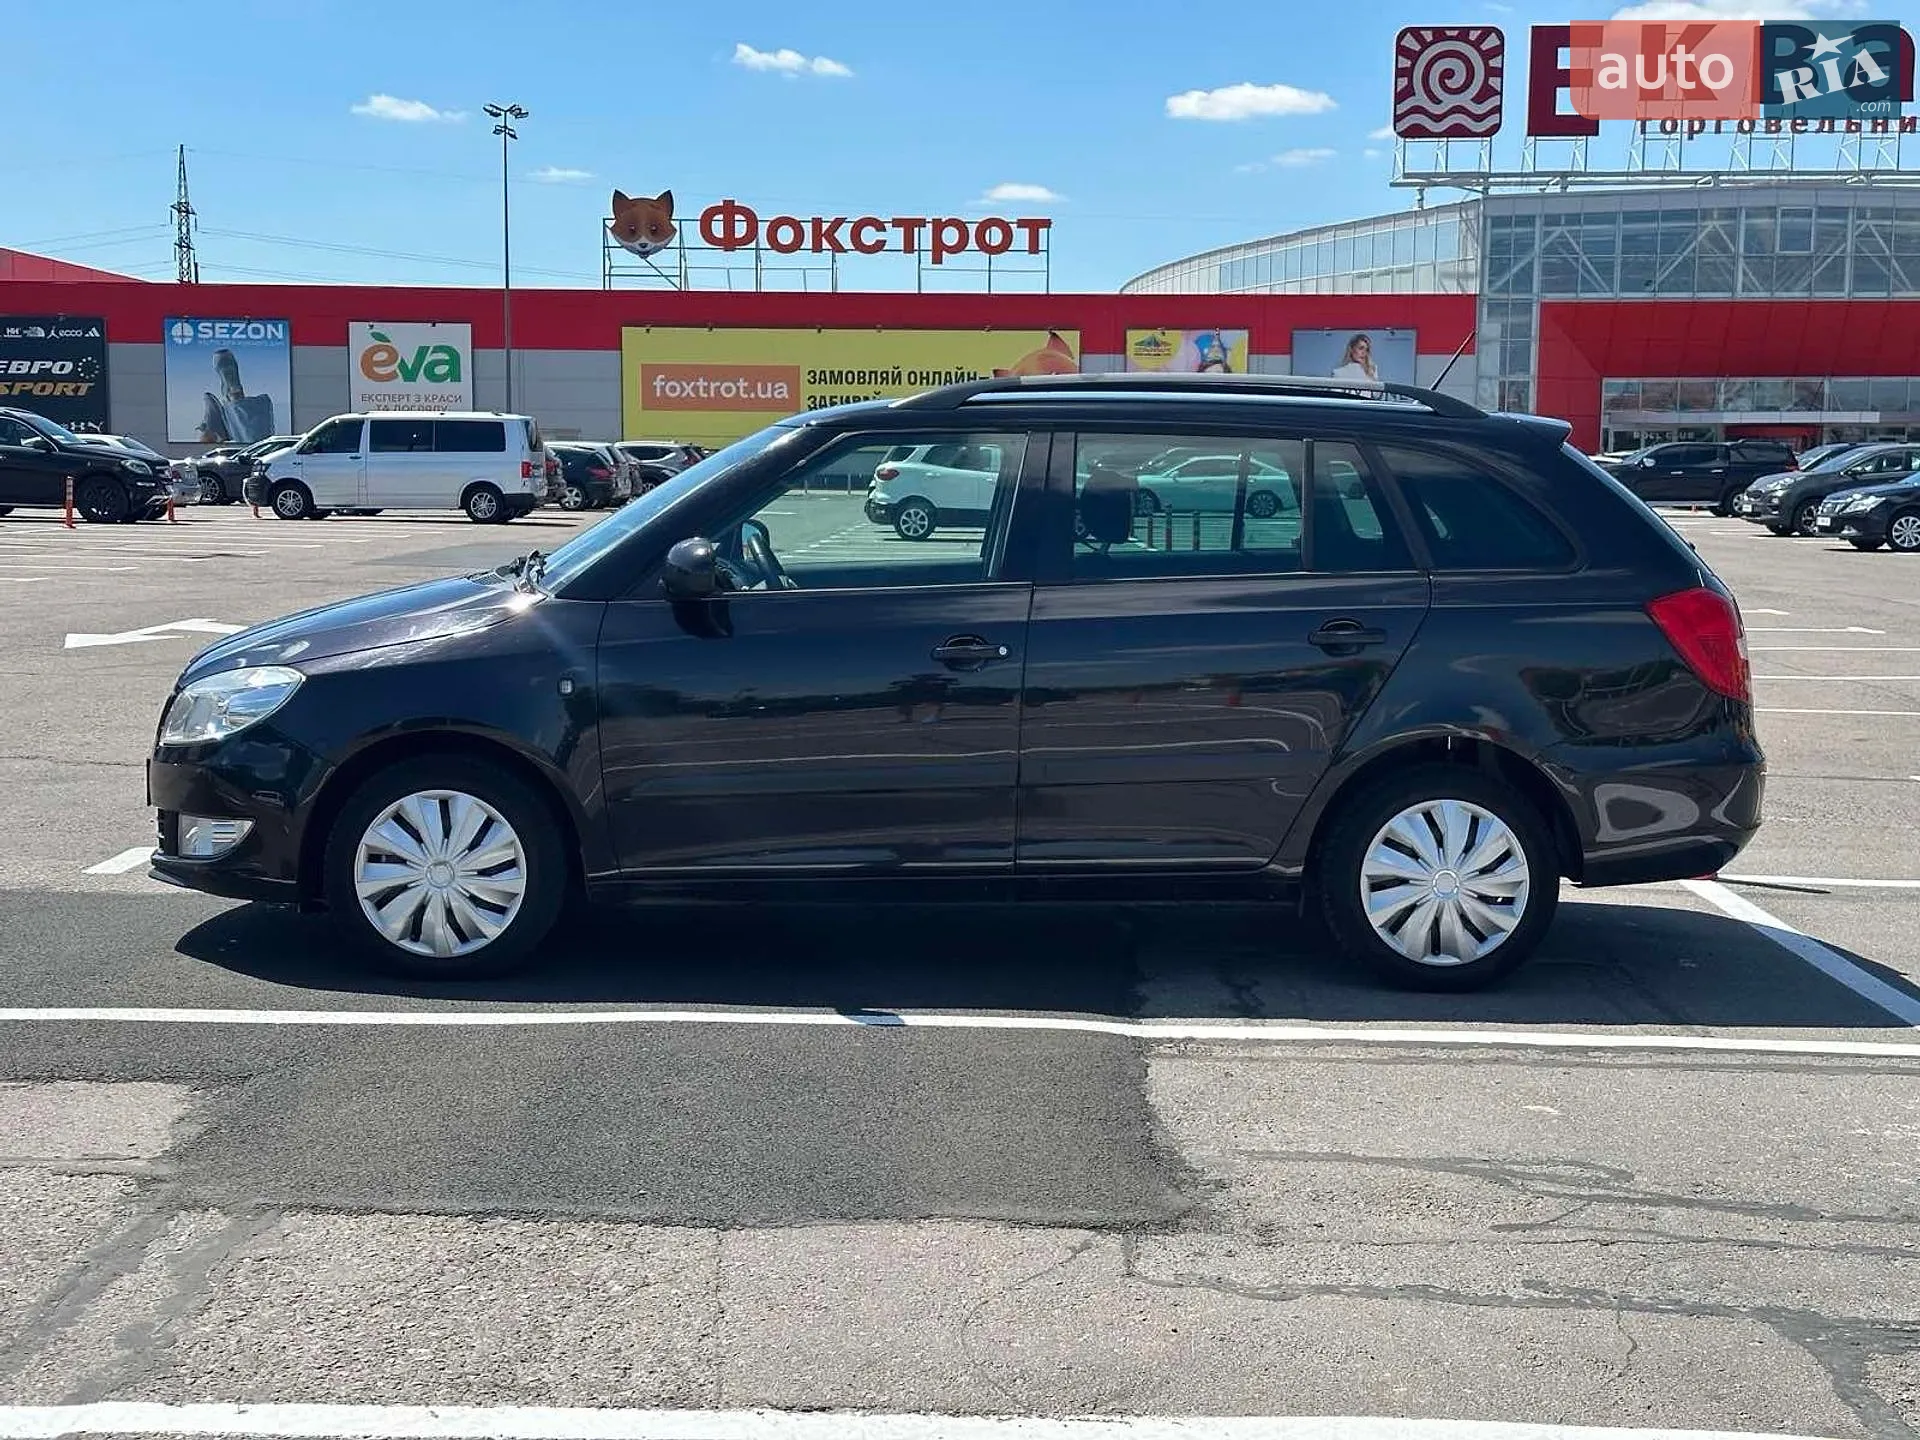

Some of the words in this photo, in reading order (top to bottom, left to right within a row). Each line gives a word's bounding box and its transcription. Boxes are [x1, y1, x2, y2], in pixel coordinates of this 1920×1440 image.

[700, 199, 1052, 265] Фокстрот
[198, 323, 283, 339] SEZON
[807, 366, 902, 385] ЗАМОВЛЯЙ
[653, 374, 789, 399] foxtrot.ua
[361, 393, 411, 403] ЕКСПЕРТ
[424, 394, 462, 403] КРАСИ
